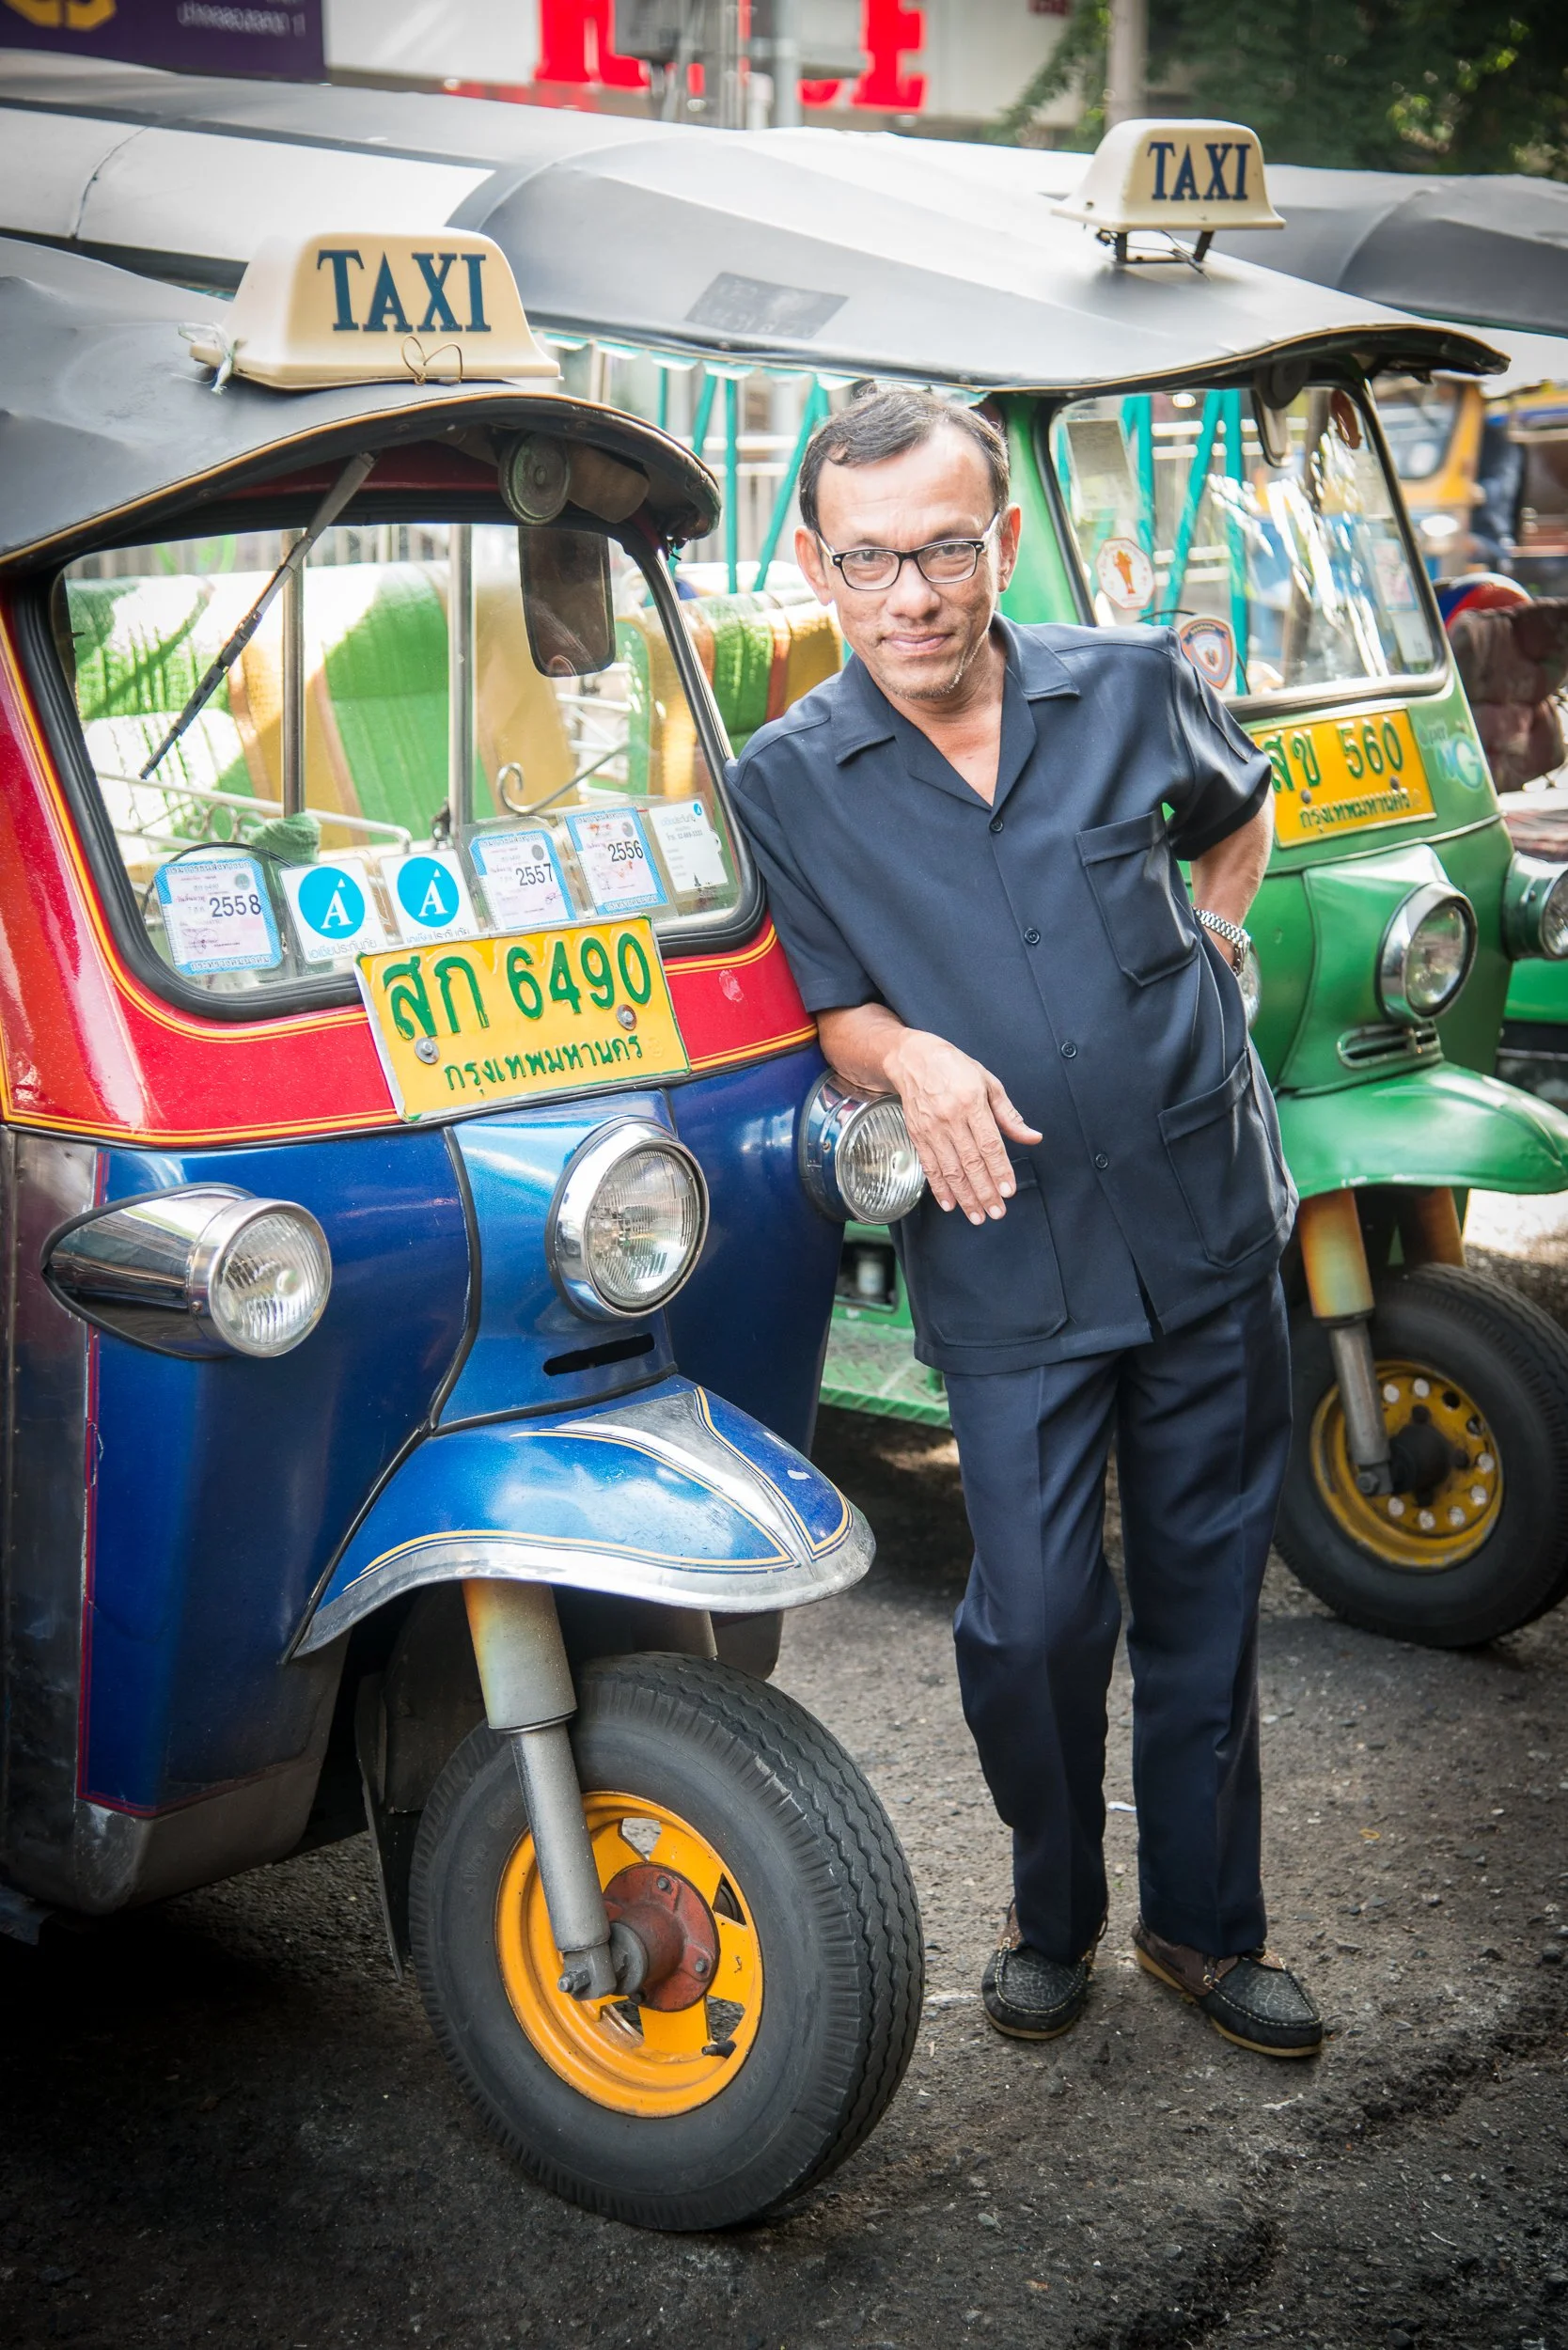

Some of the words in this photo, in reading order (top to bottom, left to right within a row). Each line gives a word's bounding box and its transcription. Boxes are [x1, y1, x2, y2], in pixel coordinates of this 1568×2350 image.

[1147, 141, 1252, 202] TAXI
[317, 248, 492, 333] TAXI
[1336, 716, 1403, 779] 560
[1299, 788, 1410, 834] กรุงเทพมหานคร
[515, 863, 553, 886] 2557
[607, 839, 644, 862] 2556
[210, 894, 262, 918] 2558
[383, 955, 490, 1040] สก
[507, 932, 651, 1020] 6490
[444, 1034, 644, 1095] กรุงเทพมหานคร
